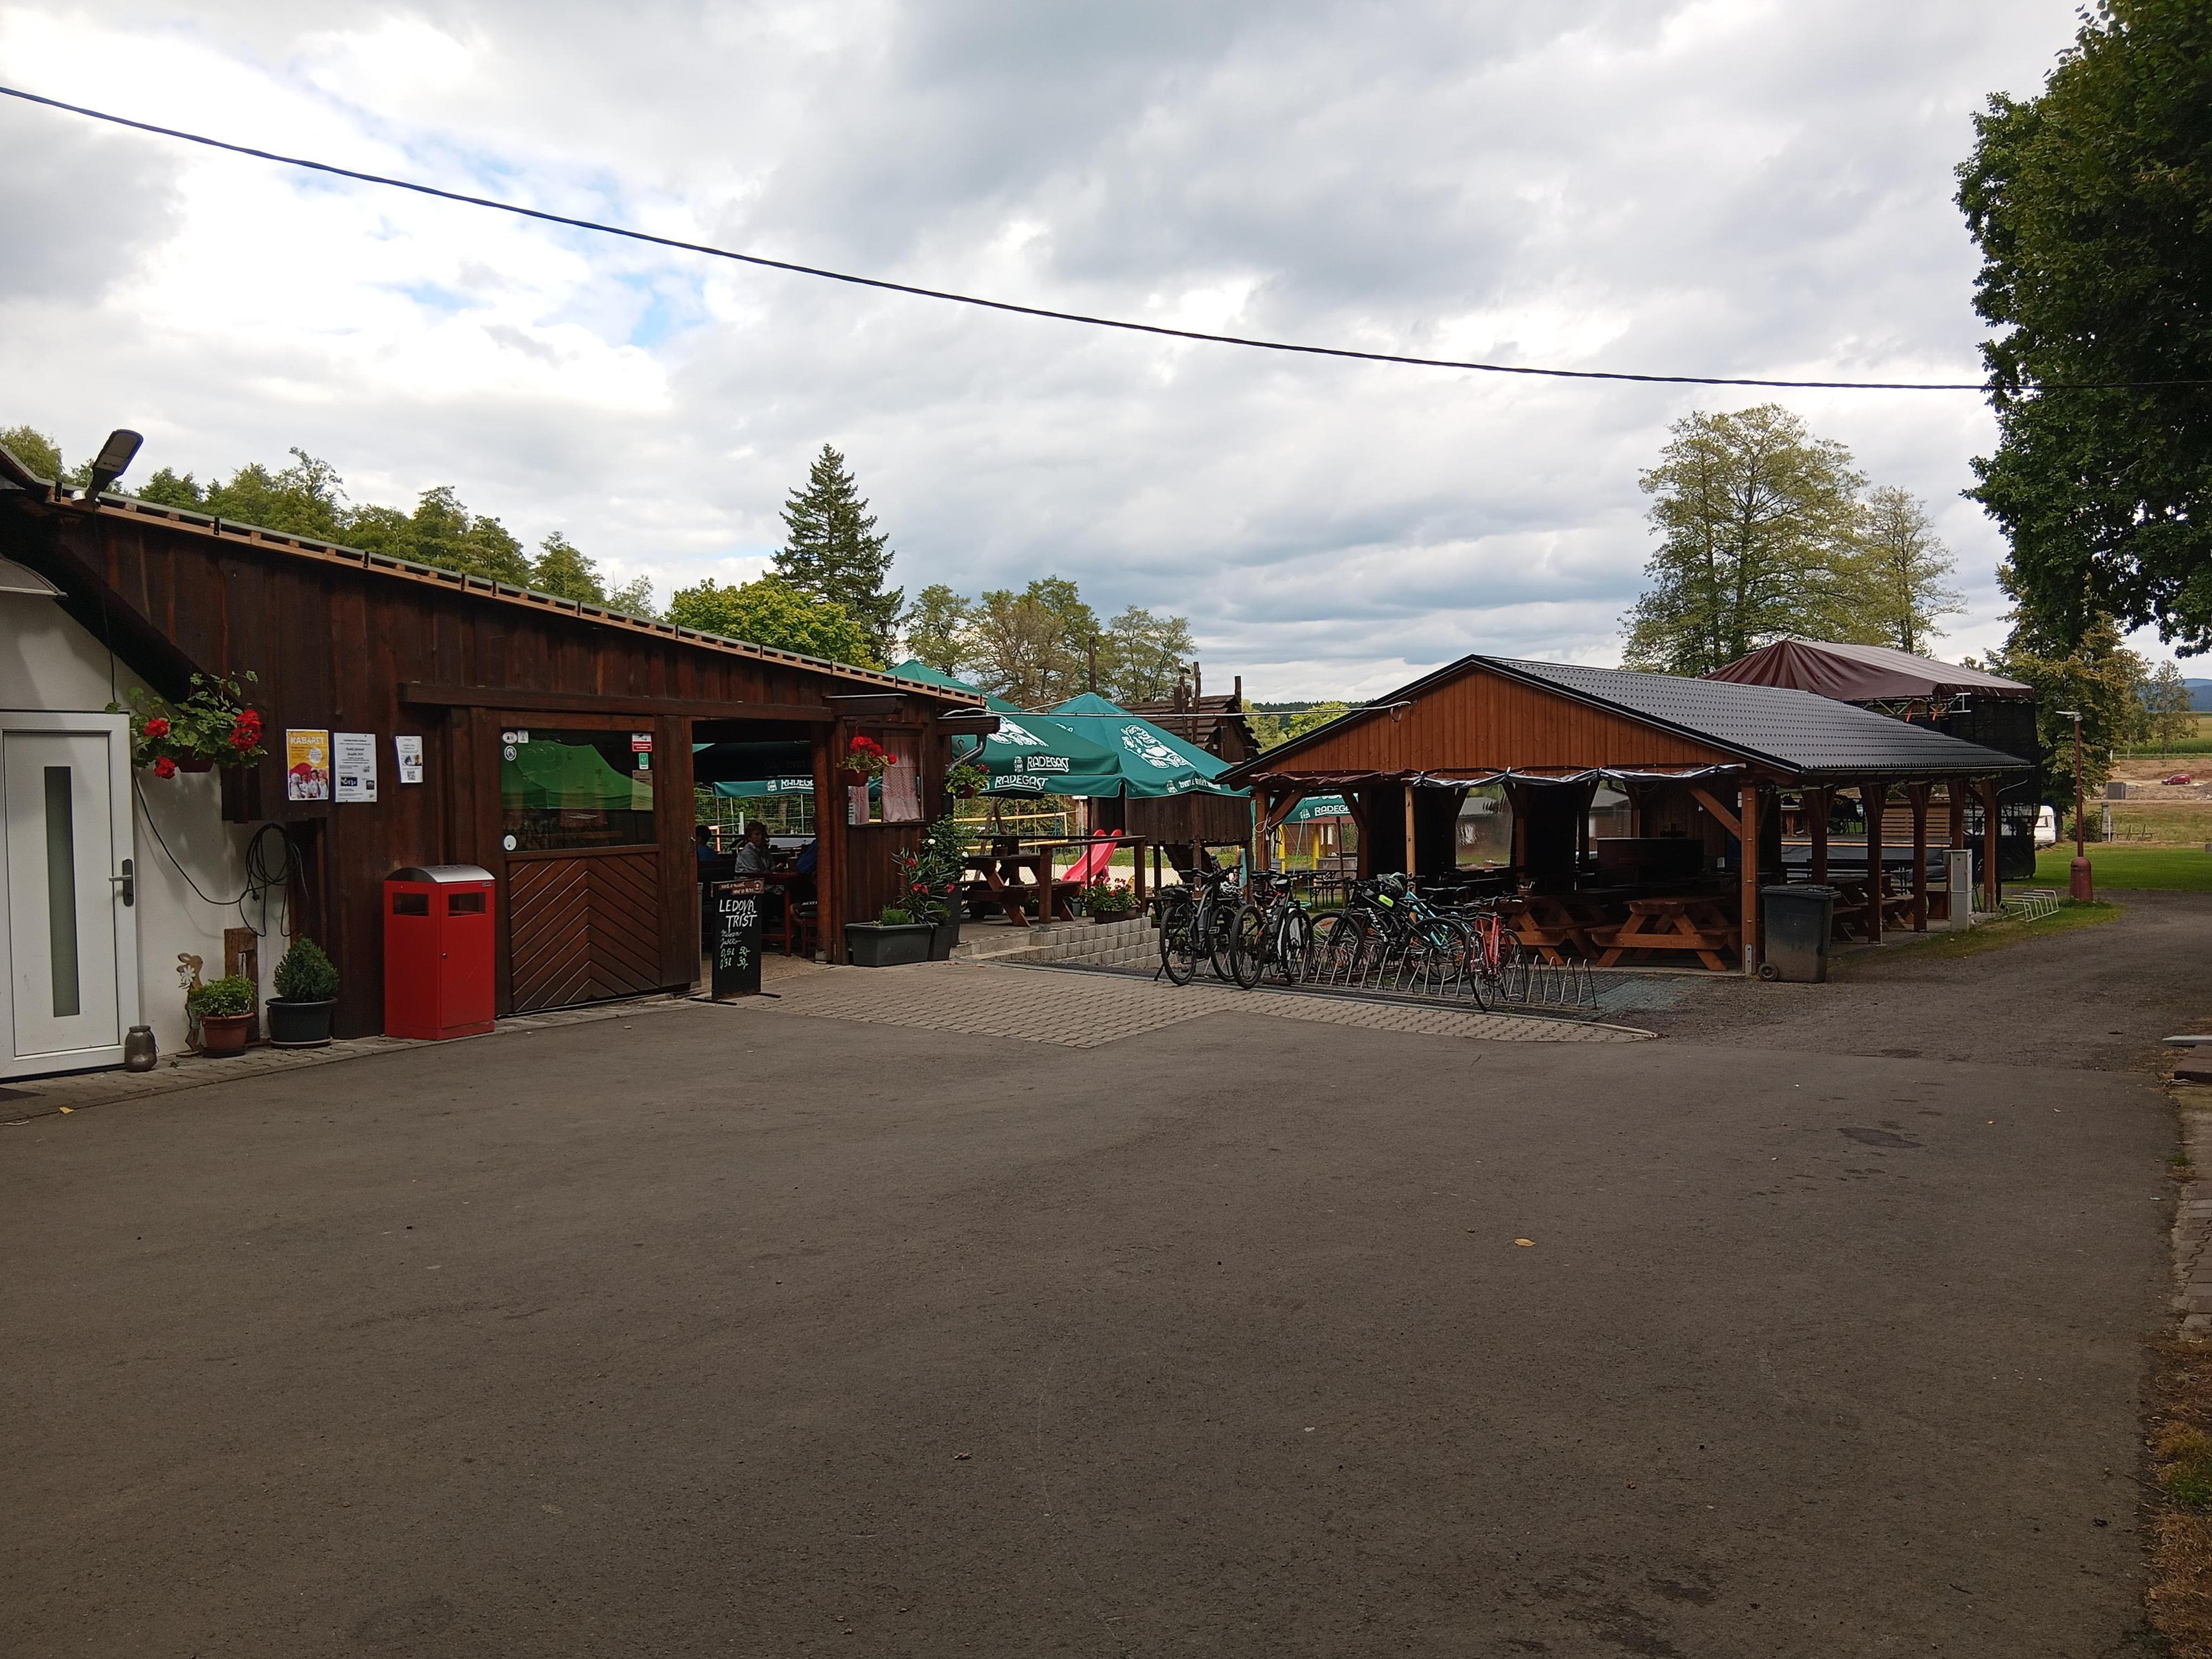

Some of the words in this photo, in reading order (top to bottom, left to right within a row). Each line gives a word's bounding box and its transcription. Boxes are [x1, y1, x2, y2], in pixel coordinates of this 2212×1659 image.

[1027, 756, 1070, 772] RADEGAST
[995, 775, 1048, 791] RADEGAST
[719, 895, 757, 913] LEDOVÁ
